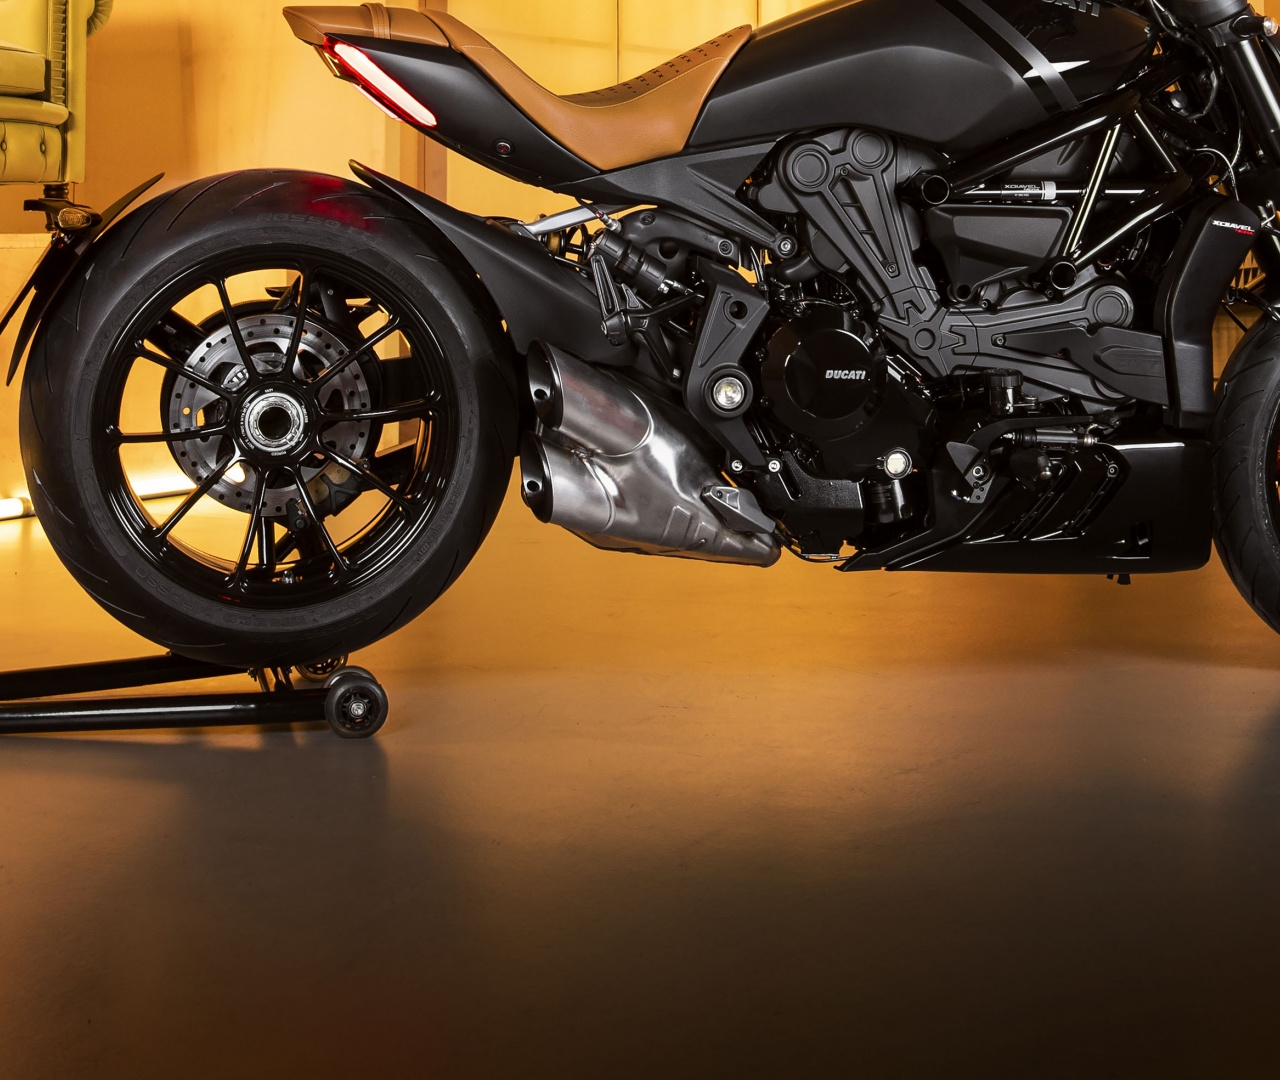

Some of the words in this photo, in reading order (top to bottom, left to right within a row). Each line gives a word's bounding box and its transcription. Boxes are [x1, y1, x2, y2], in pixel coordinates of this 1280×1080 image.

[1211, 220, 1255, 232] XDIAVEL
[825, 369, 866, 380] DUCATI
[132, 563, 197, 611] ROSSO
